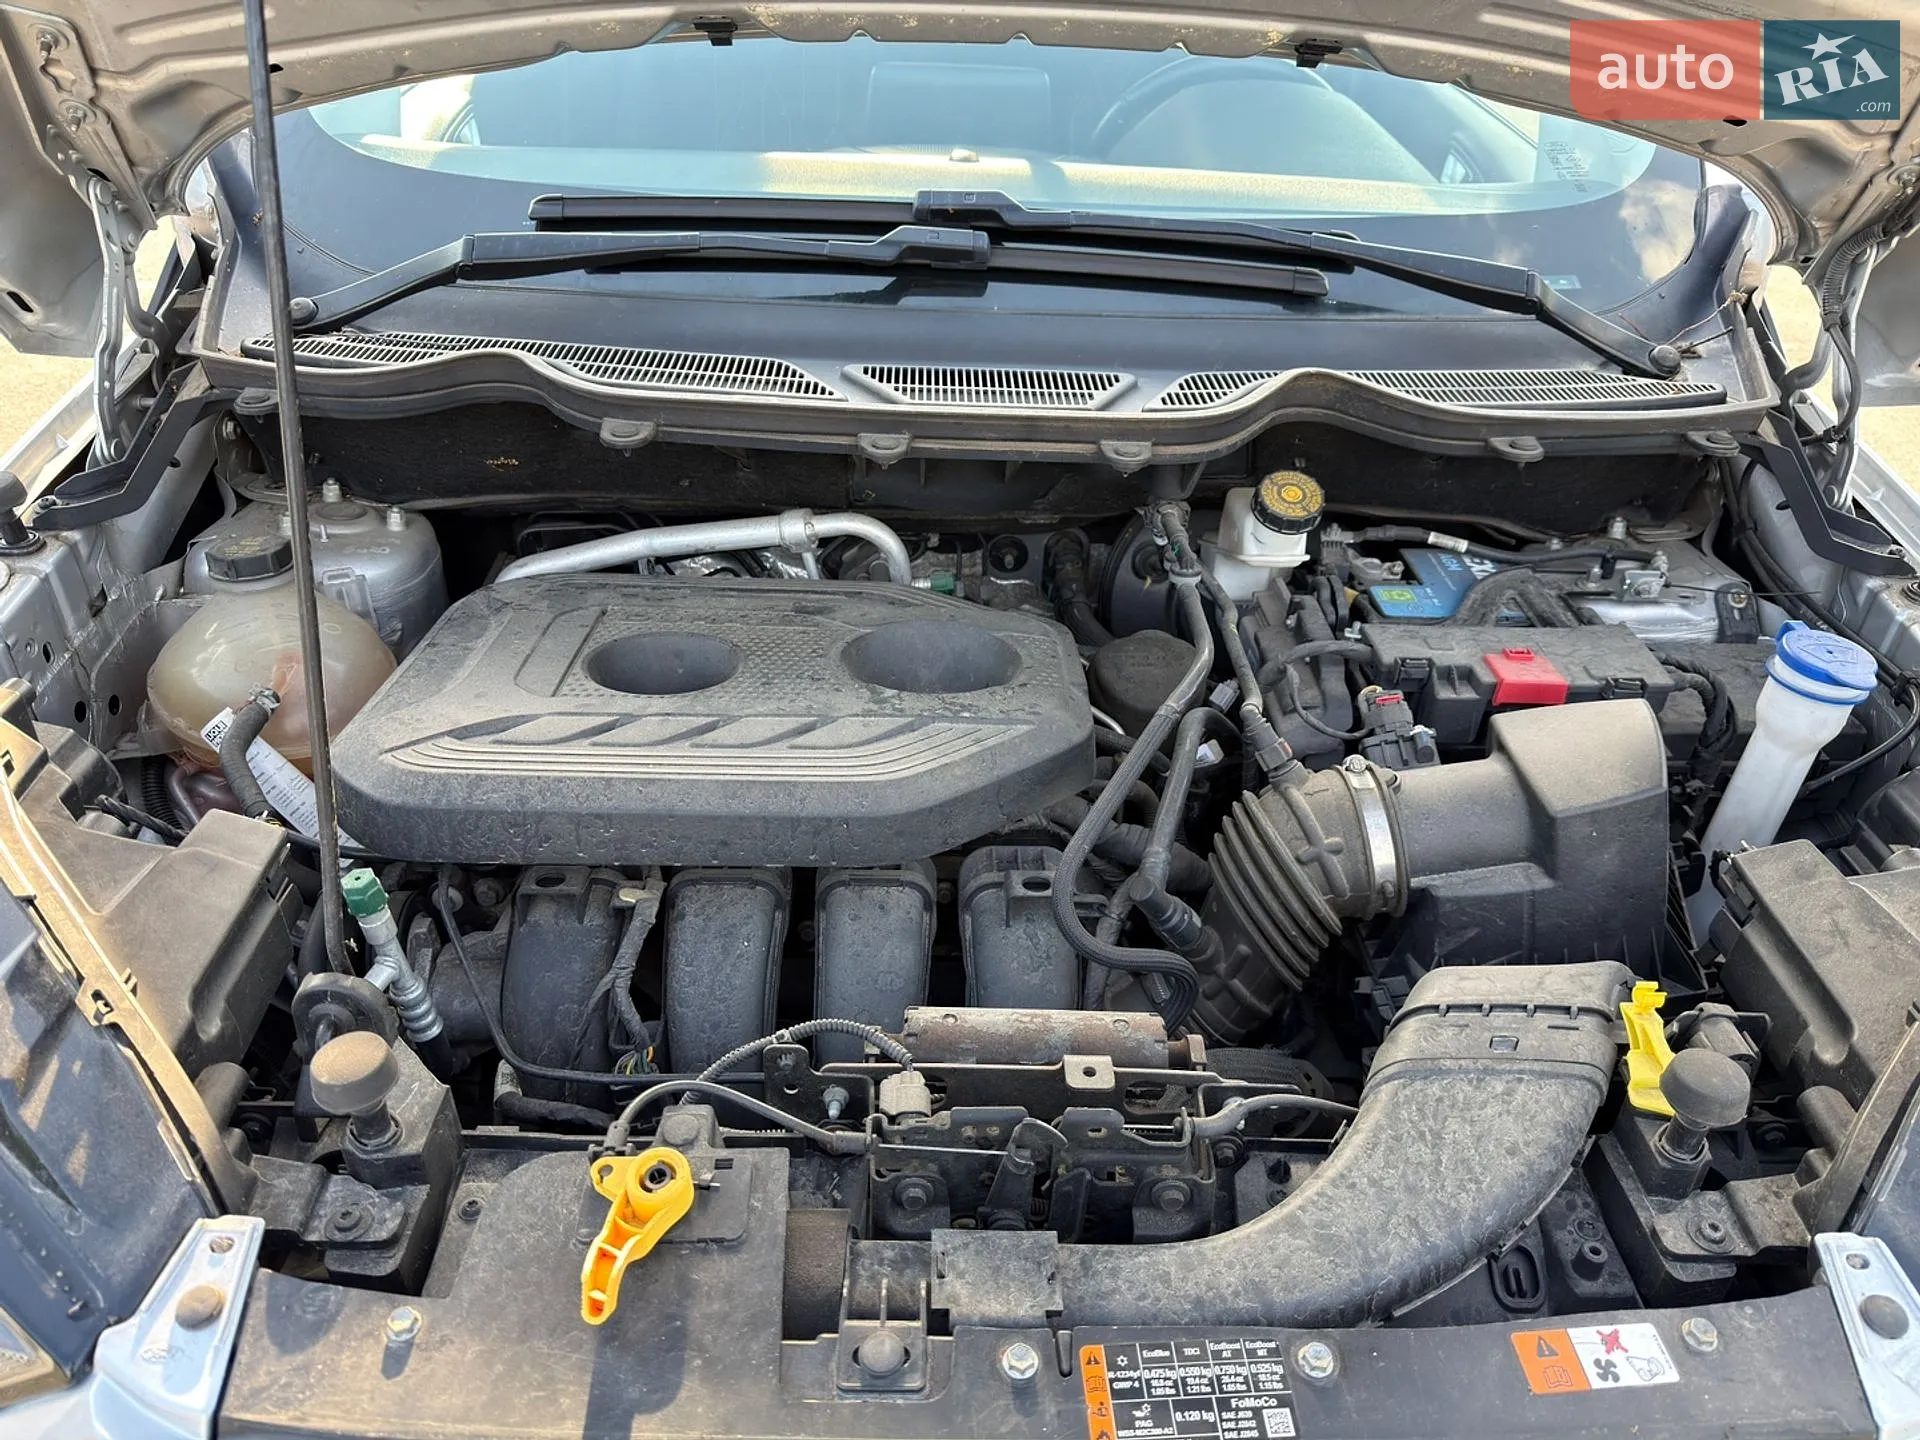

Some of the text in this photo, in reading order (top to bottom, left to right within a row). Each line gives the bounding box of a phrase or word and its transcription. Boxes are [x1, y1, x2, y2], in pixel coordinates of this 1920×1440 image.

[1144, 1367, 1178, 1380] 0.475 kg
[1179, 1365, 1212, 1378] 0.550 kg
[1214, 1364, 1248, 1376] 0.750 kg
[1272, 1362, 1284, 1374] kg
[1230, 1396, 1278, 1409] FoMoCo
[1174, 1410, 1216, 1423] 0.120 kg
